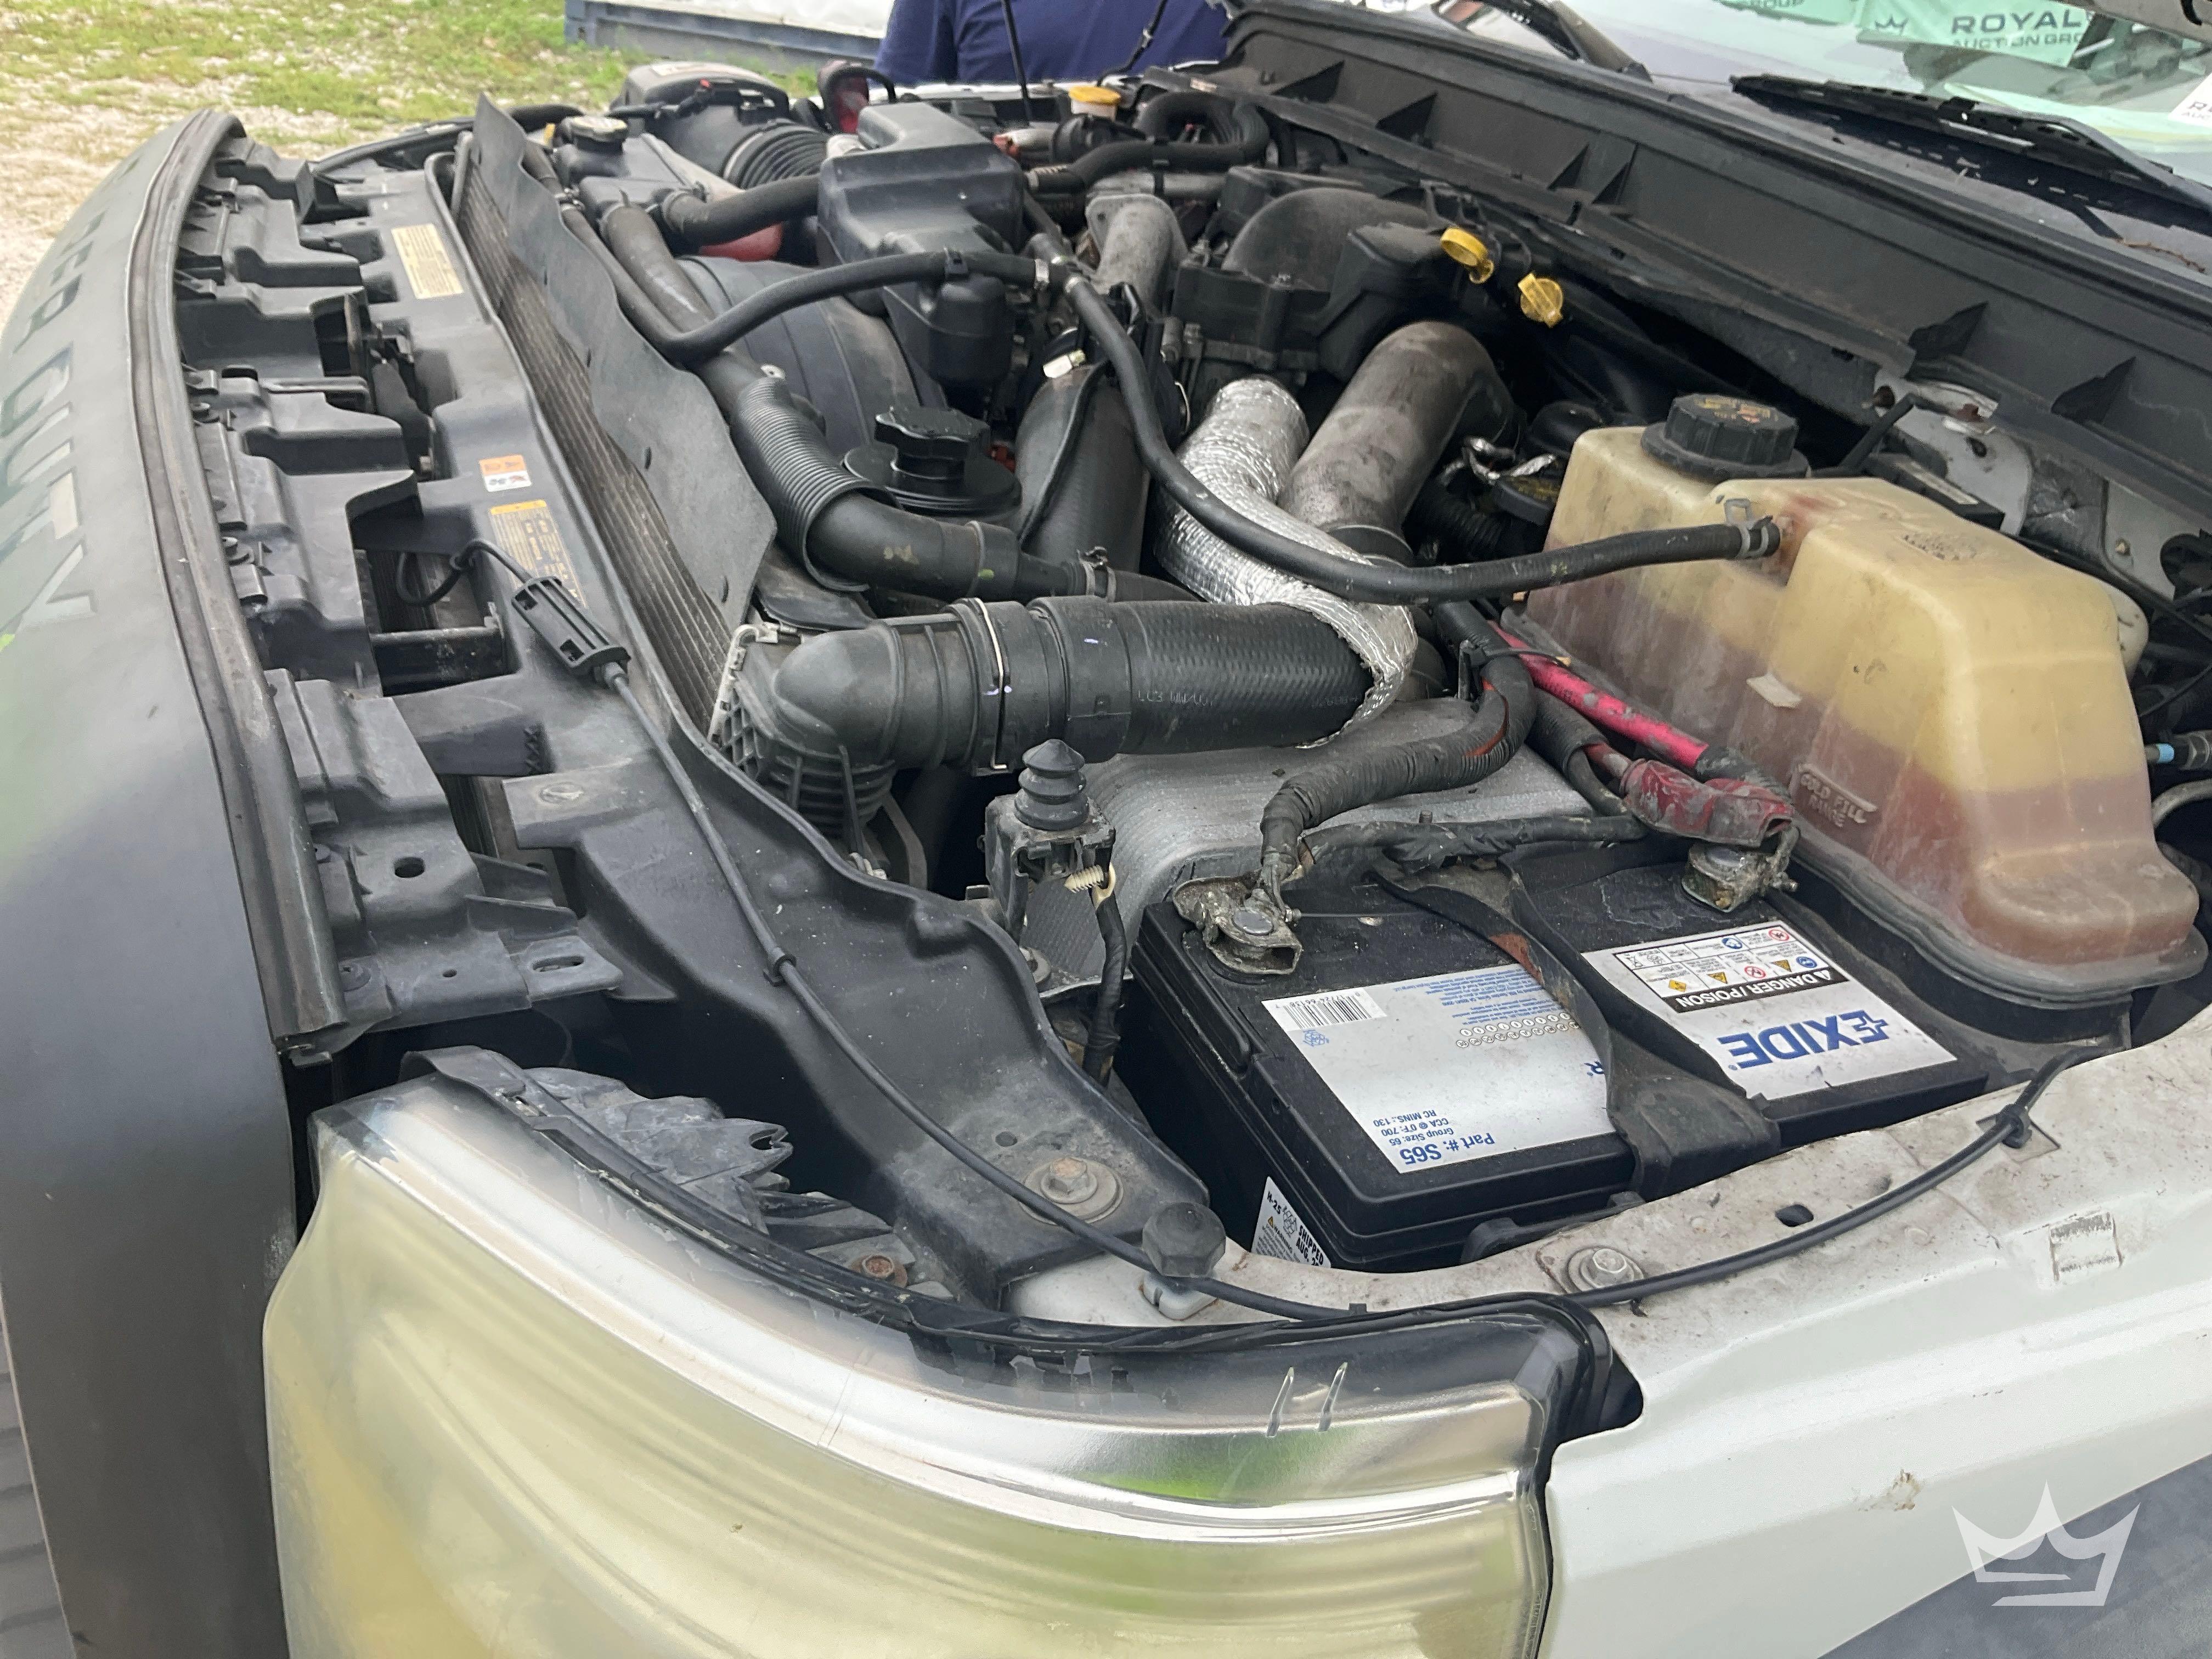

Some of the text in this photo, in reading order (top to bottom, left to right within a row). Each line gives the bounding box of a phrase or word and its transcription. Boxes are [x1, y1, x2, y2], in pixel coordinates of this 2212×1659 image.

[1951, 9, 2083, 35] ROYAL
[1801, 773, 1867, 824] COLD FILL
[1746, 973, 1818, 994] DANGER
[1716, 1009, 1889, 1069] EXIDE
[1373, 1118, 1391, 1127] 130
[1423, 1109, 1437, 1118] RC
[1429, 1118, 1449, 1127] CCA
[1380, 1127, 1400, 1137] 700
[1389, 1127, 1454, 1146] Group Size: 65
[1400, 1133, 1495, 1165] Part #: S65
[1299, 1224, 1324, 1266] SHIPPED
